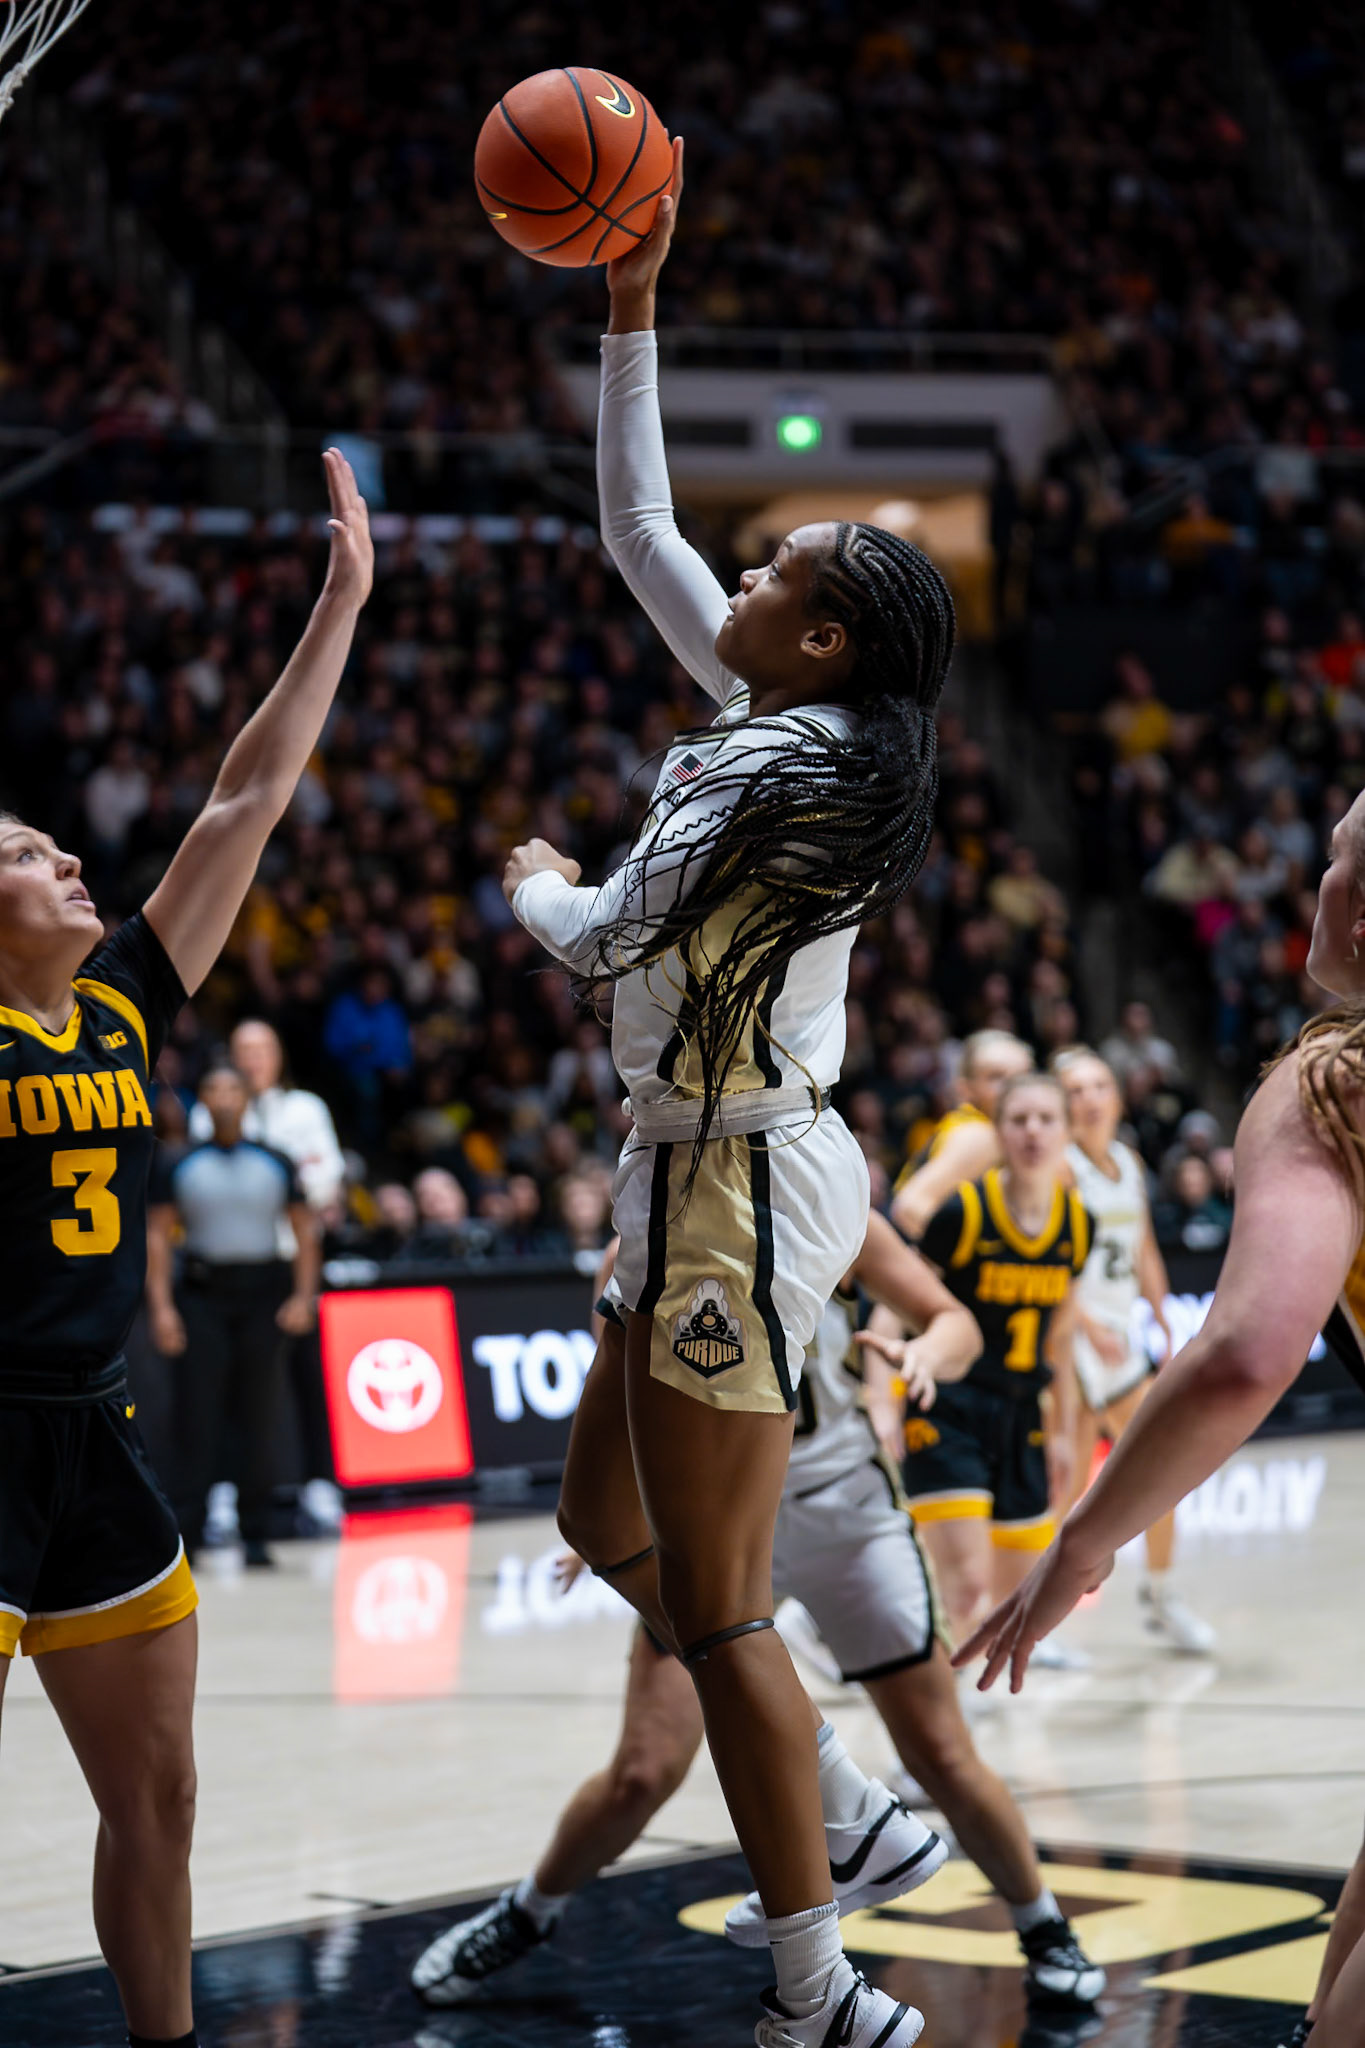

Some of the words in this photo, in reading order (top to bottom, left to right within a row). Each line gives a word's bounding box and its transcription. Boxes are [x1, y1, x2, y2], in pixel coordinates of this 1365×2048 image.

[0, 1068, 152, 1137] IOWA
[51, 1147, 120, 1256] 3
[677, 1339, 740, 1368] PURDUE
[1004, 1308, 1041, 1373] 1
